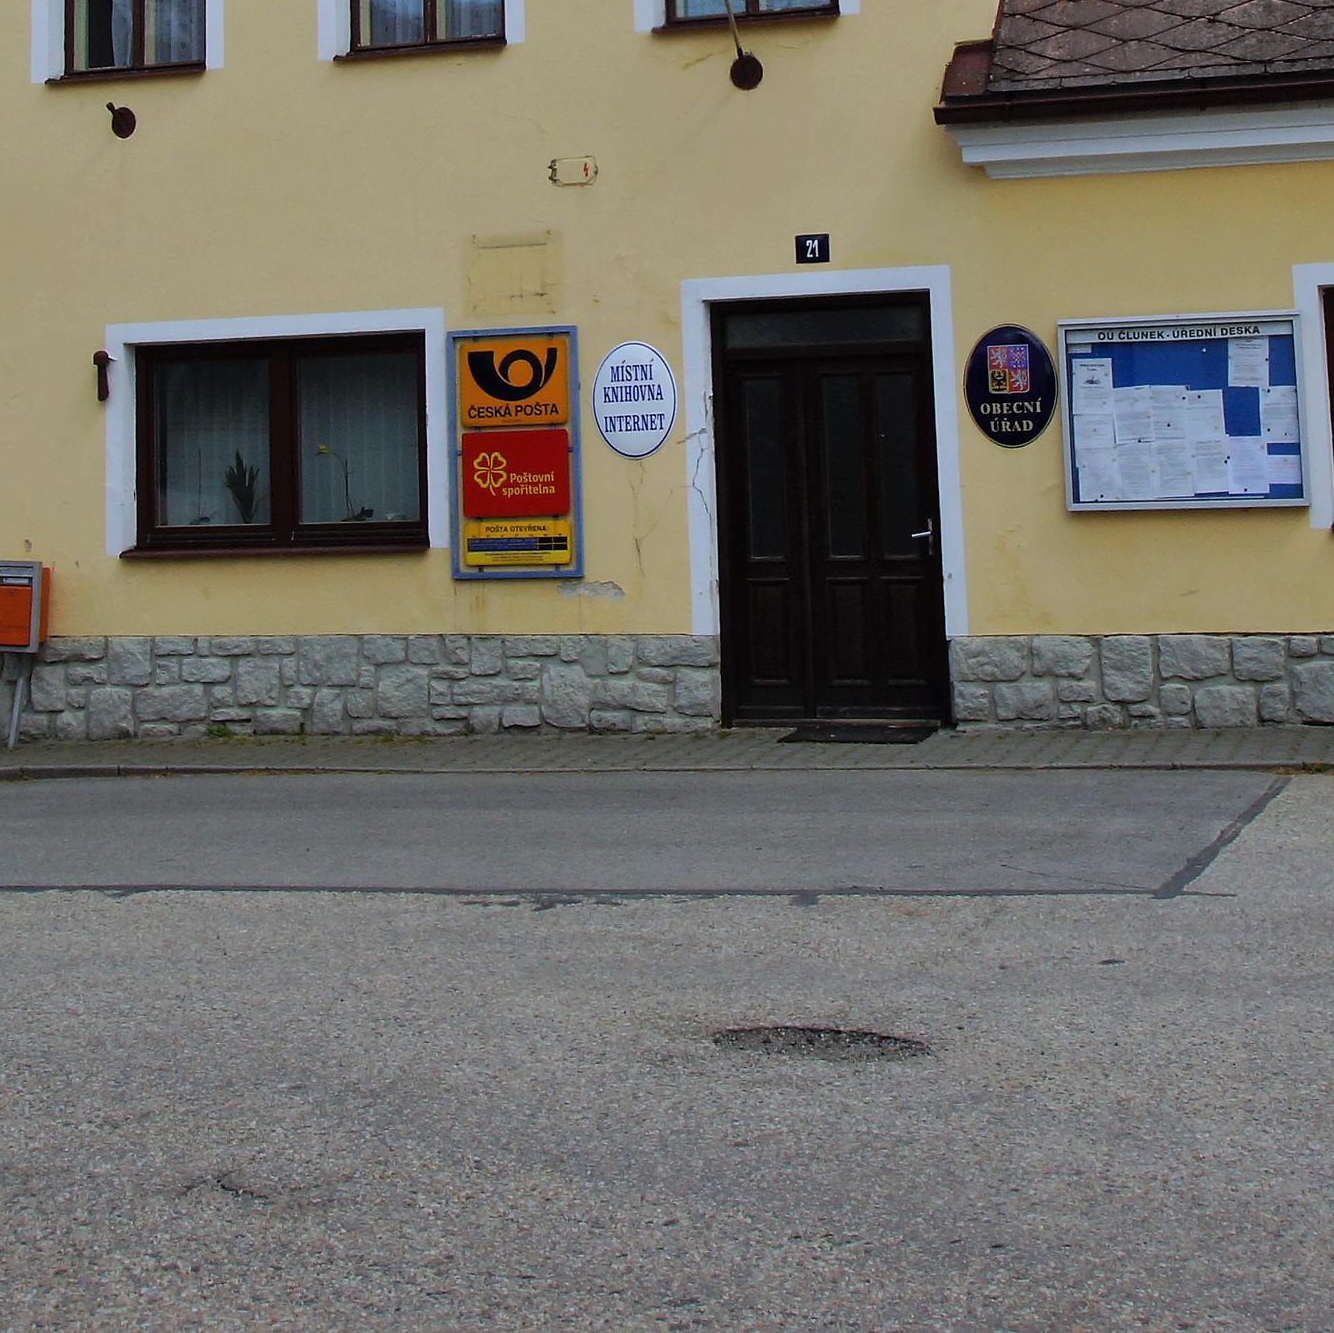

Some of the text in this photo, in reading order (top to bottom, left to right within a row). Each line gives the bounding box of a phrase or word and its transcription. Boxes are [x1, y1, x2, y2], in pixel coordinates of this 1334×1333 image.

[806, 239, 819, 258] 21
[1220, 326, 1260, 336] DESKA
[610, 358, 654, 383] MÍSTNÍ
[603, 384, 664, 404] KNIHOVNA
[467, 401, 560, 419] ČESKÁ POŠTA
[980, 397, 1042, 415] OBECNÍ
[604, 413, 666, 433] INTERNET
[990, 417, 1034, 433] ÚŘAD
[509, 471, 555, 483] Poštovní
[502, 483, 556, 498] spořitelna
[485, 524, 508, 533] POŠTA
